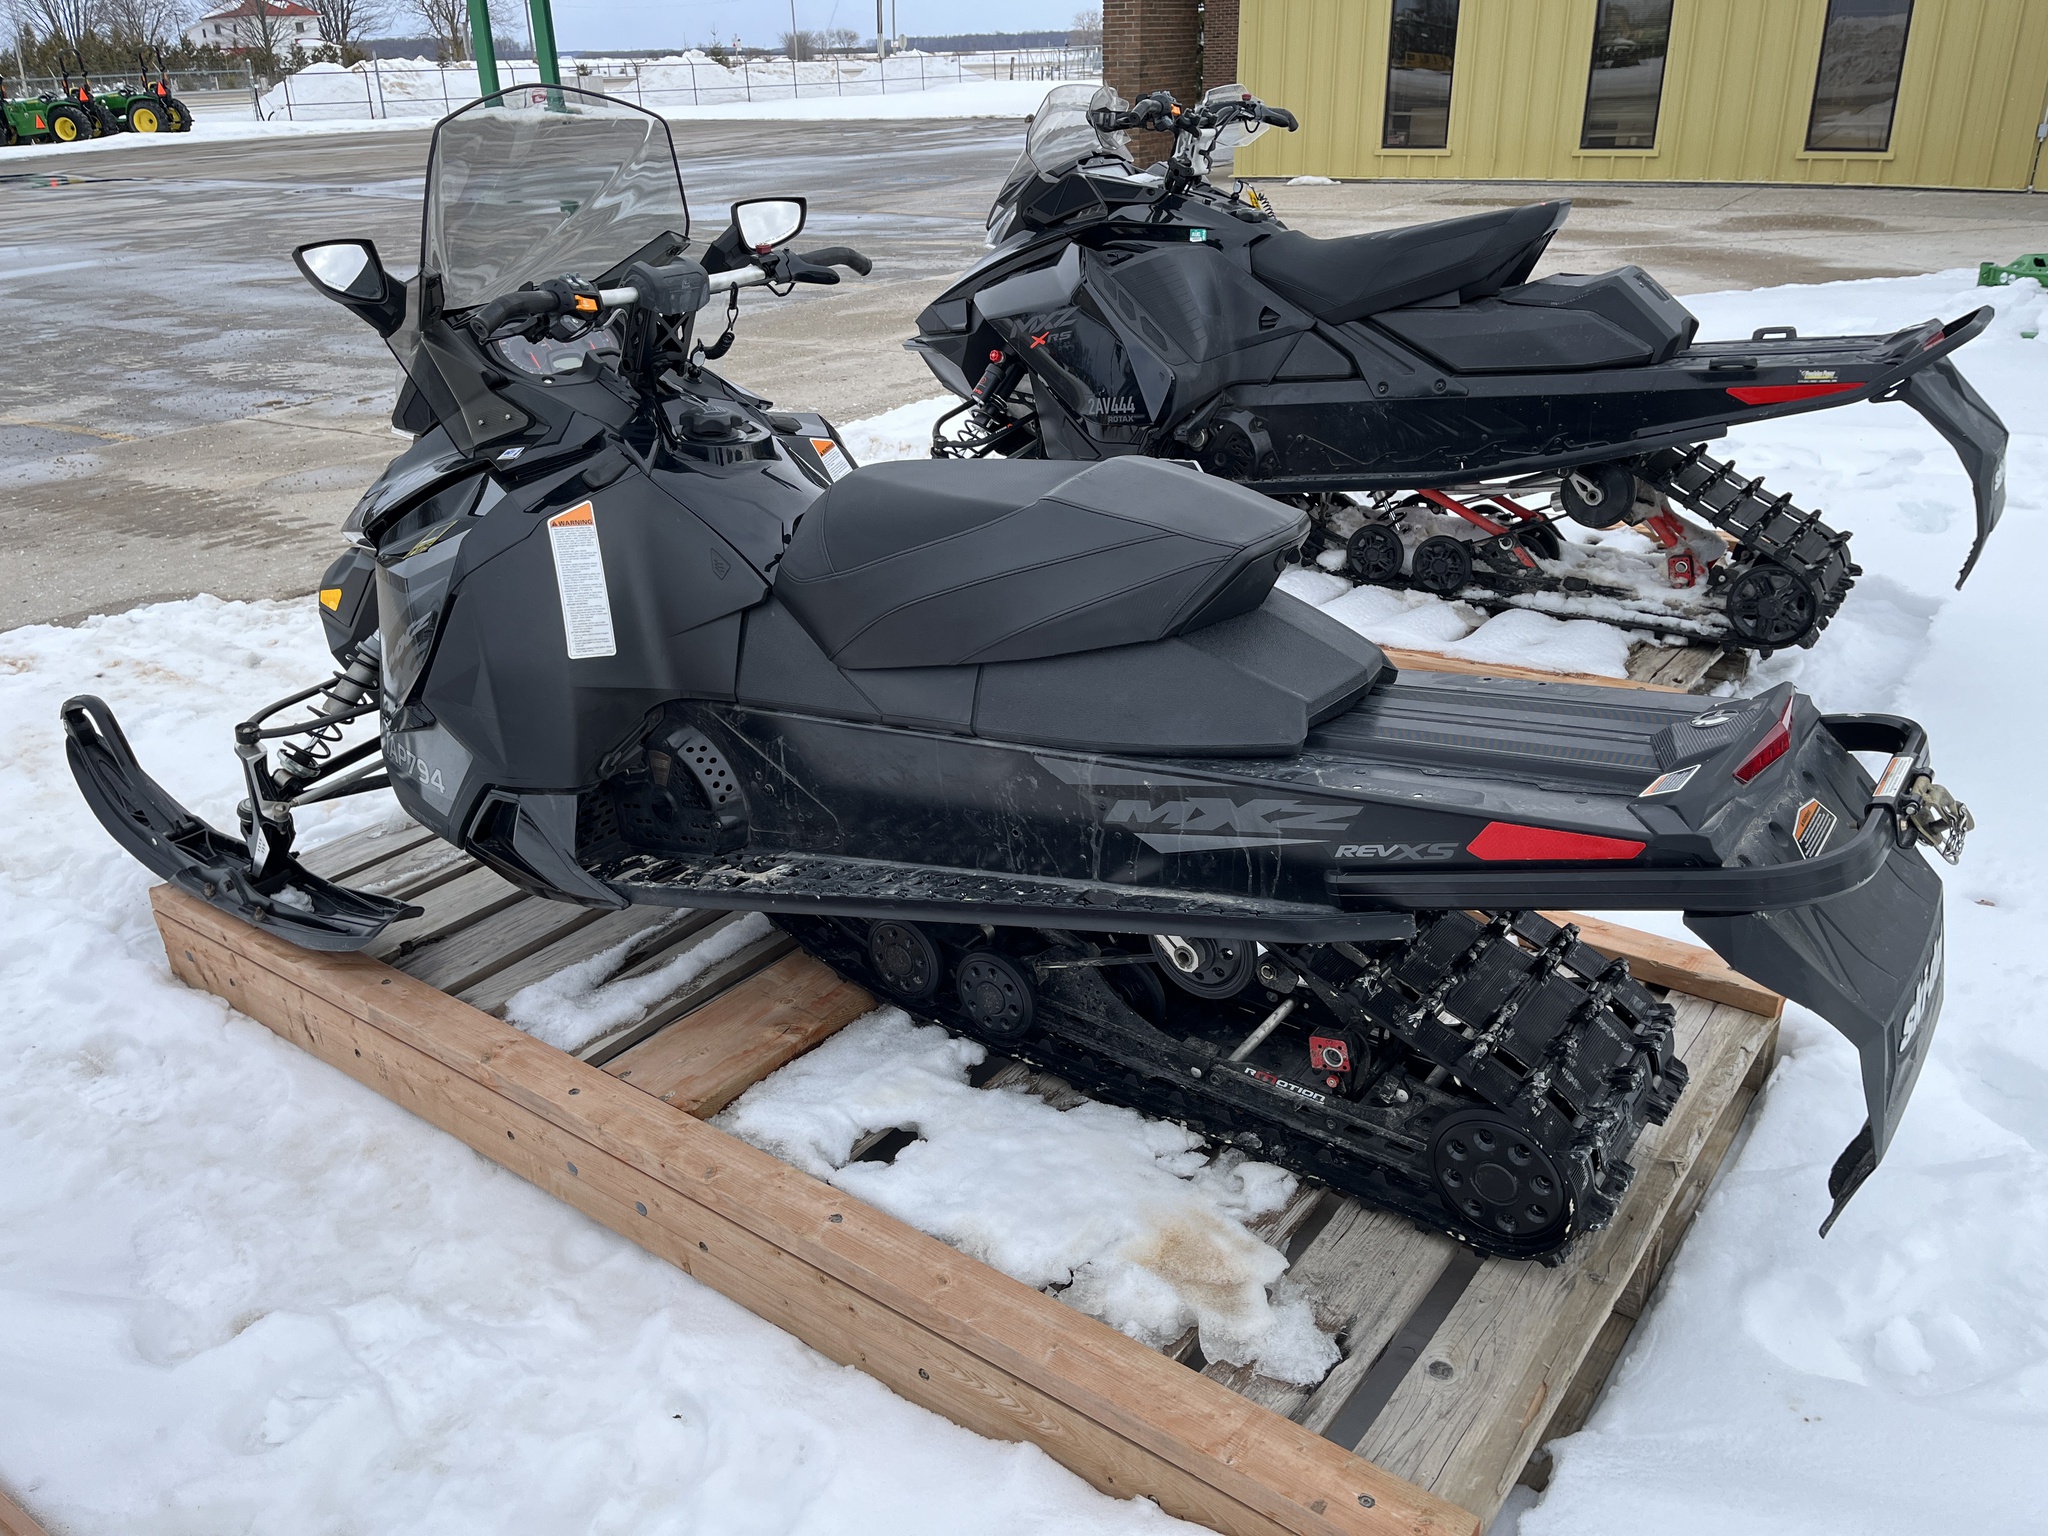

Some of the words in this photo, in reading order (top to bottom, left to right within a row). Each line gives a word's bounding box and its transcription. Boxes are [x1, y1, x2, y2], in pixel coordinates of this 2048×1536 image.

[1088, 396, 1136, 415] 2AV444
[1107, 415, 1134, 423] ROTAX
[557, 518, 593, 527] WARNING
[1104, 797, 1364, 833] MXZ
